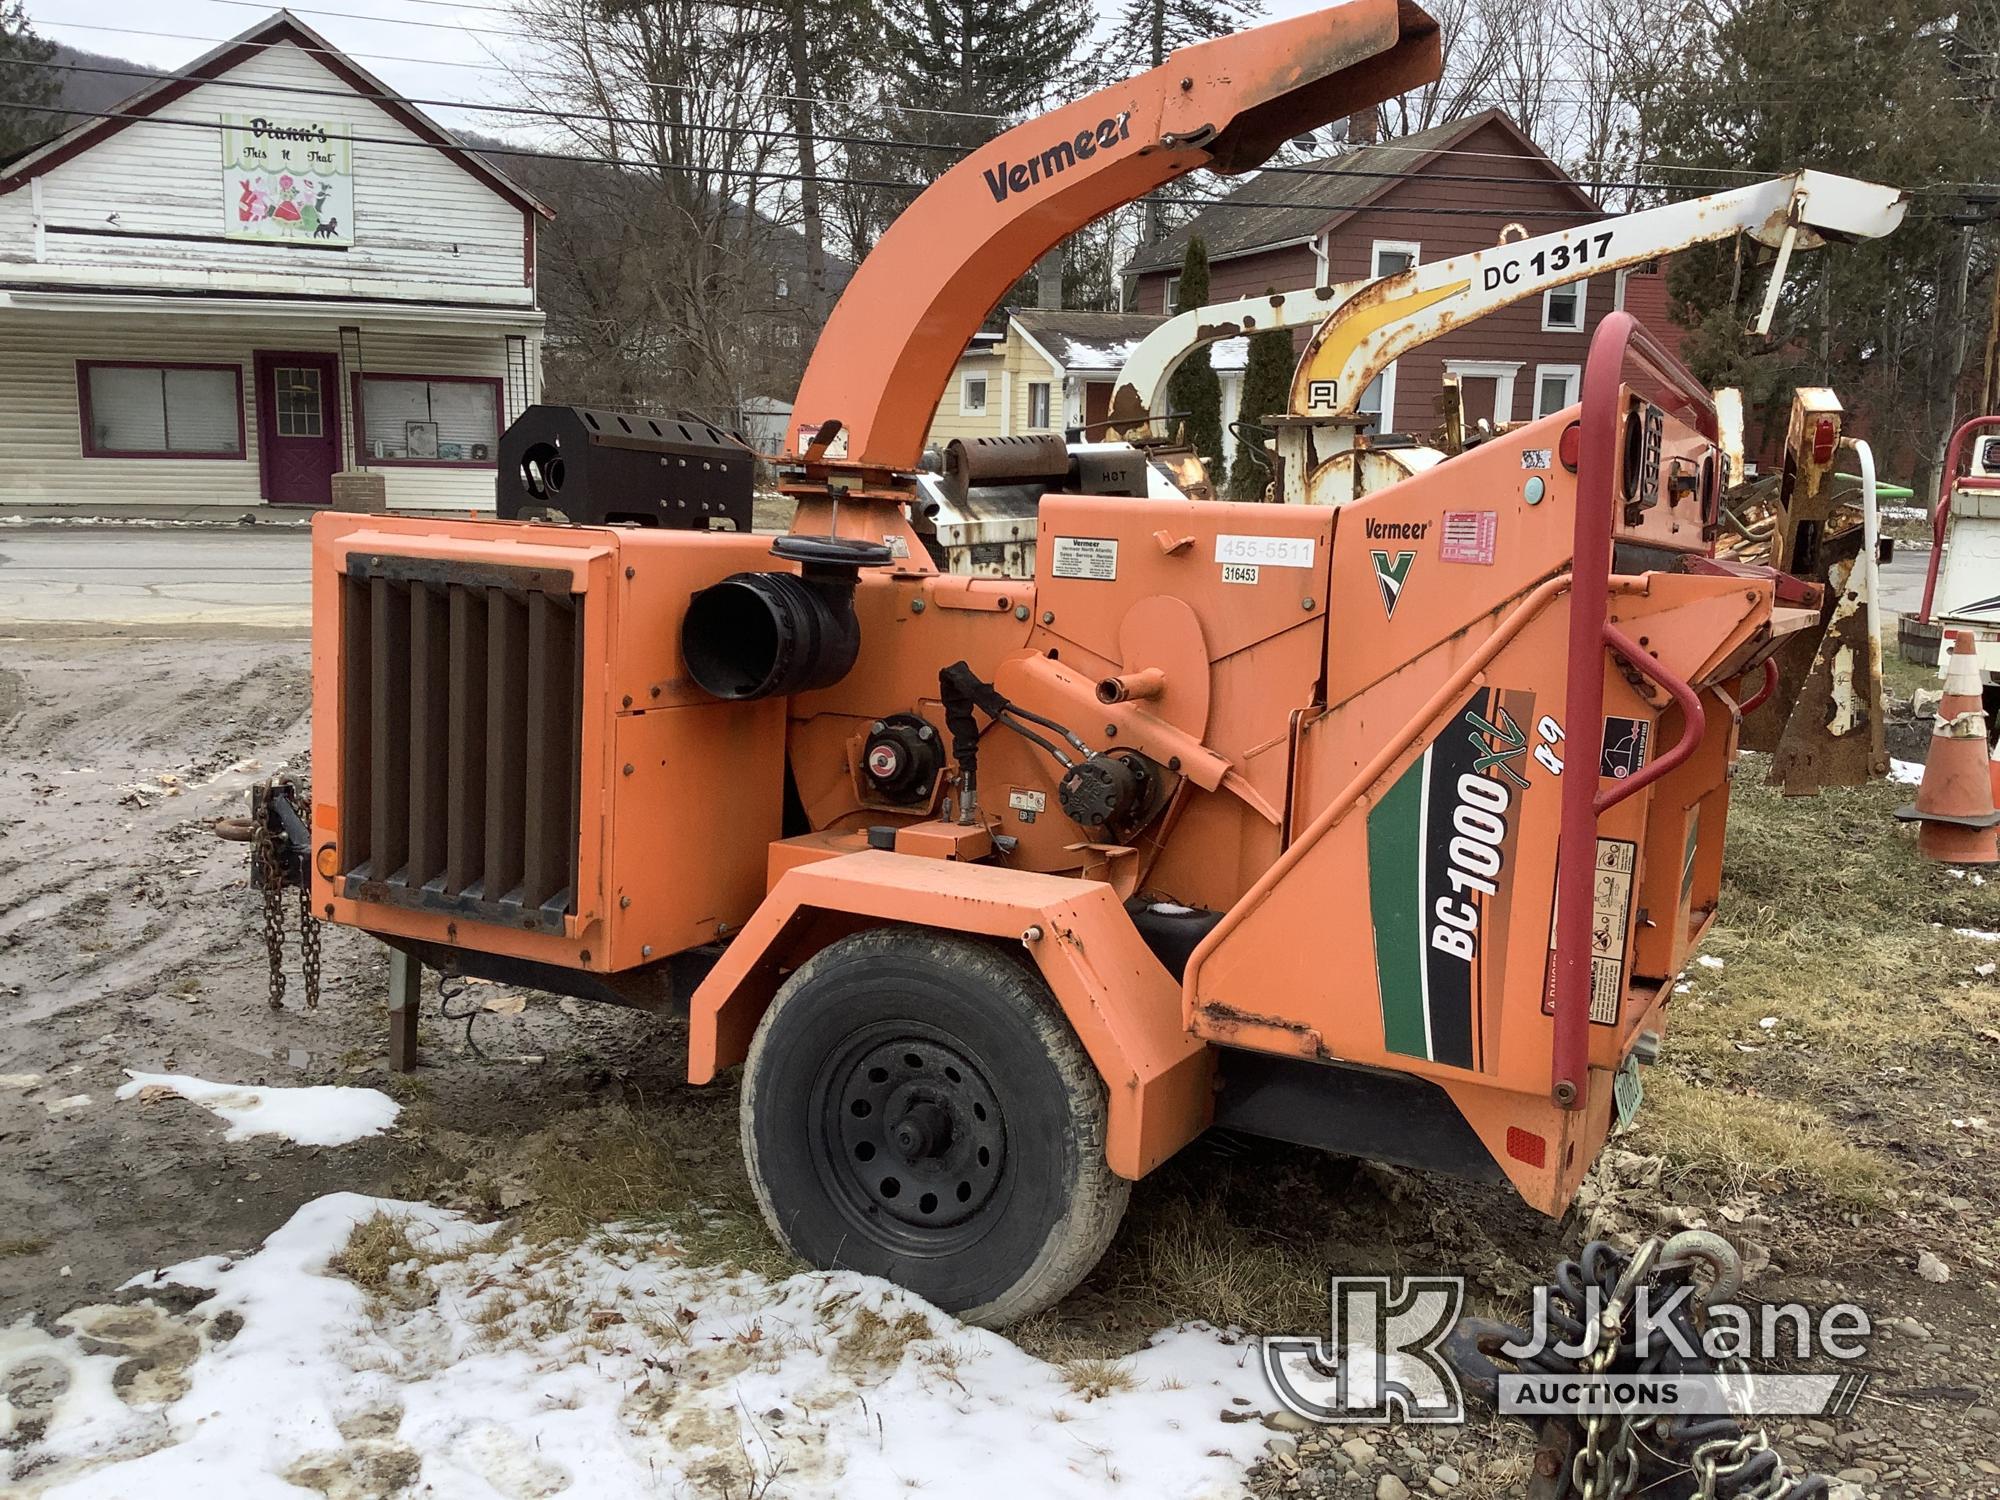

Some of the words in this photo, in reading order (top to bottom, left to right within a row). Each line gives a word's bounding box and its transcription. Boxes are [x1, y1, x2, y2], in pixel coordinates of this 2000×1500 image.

[243, 147, 267, 159] This
[307, 151, 336, 163] That
[983, 110, 1131, 203] Vermeer
[1484, 260, 1520, 291] DC
[1530, 231, 1614, 276] 1317
[1102, 471, 1127, 481] HOT
[1365, 518, 1428, 540] Vermeer
[1223, 540, 1310, 560] 455-5511
[1224, 567, 1256, 582] 316453
[1465, 706, 1531, 789] XL
[1638, 748, 1644, 756] TO
[1431, 772, 1511, 962] BC1000
